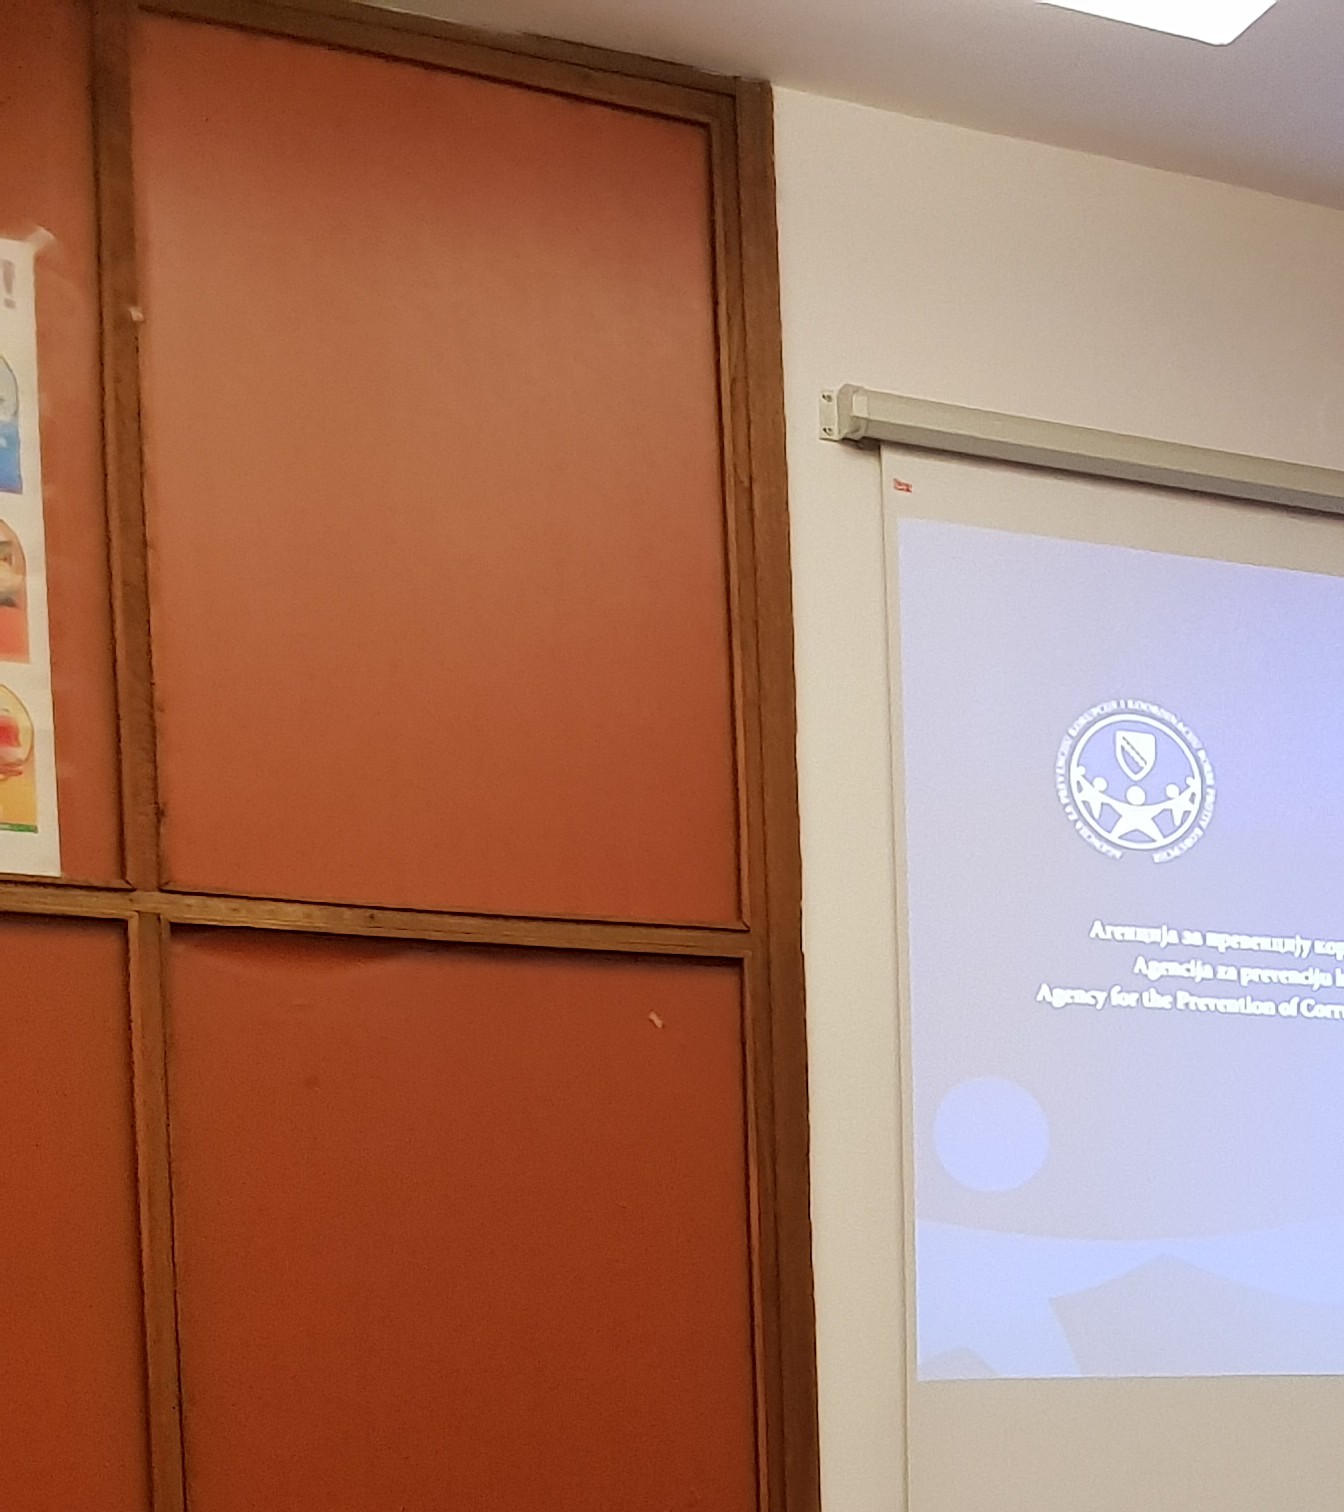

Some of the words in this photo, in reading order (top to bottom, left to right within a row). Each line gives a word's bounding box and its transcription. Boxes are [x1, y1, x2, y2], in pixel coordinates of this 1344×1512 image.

[1133, 955, 1214, 982] Agencija
[1216, 963, 1238, 980] za
[1240, 966, 1333, 991] prevenciju
[1036, 983, 1107, 1010] Agency
[1109, 985, 1141, 1007] for
[1142, 988, 1173, 1009] the
[1176, 990, 1276, 1016] Prevention
[1278, 997, 1299, 1016] of
